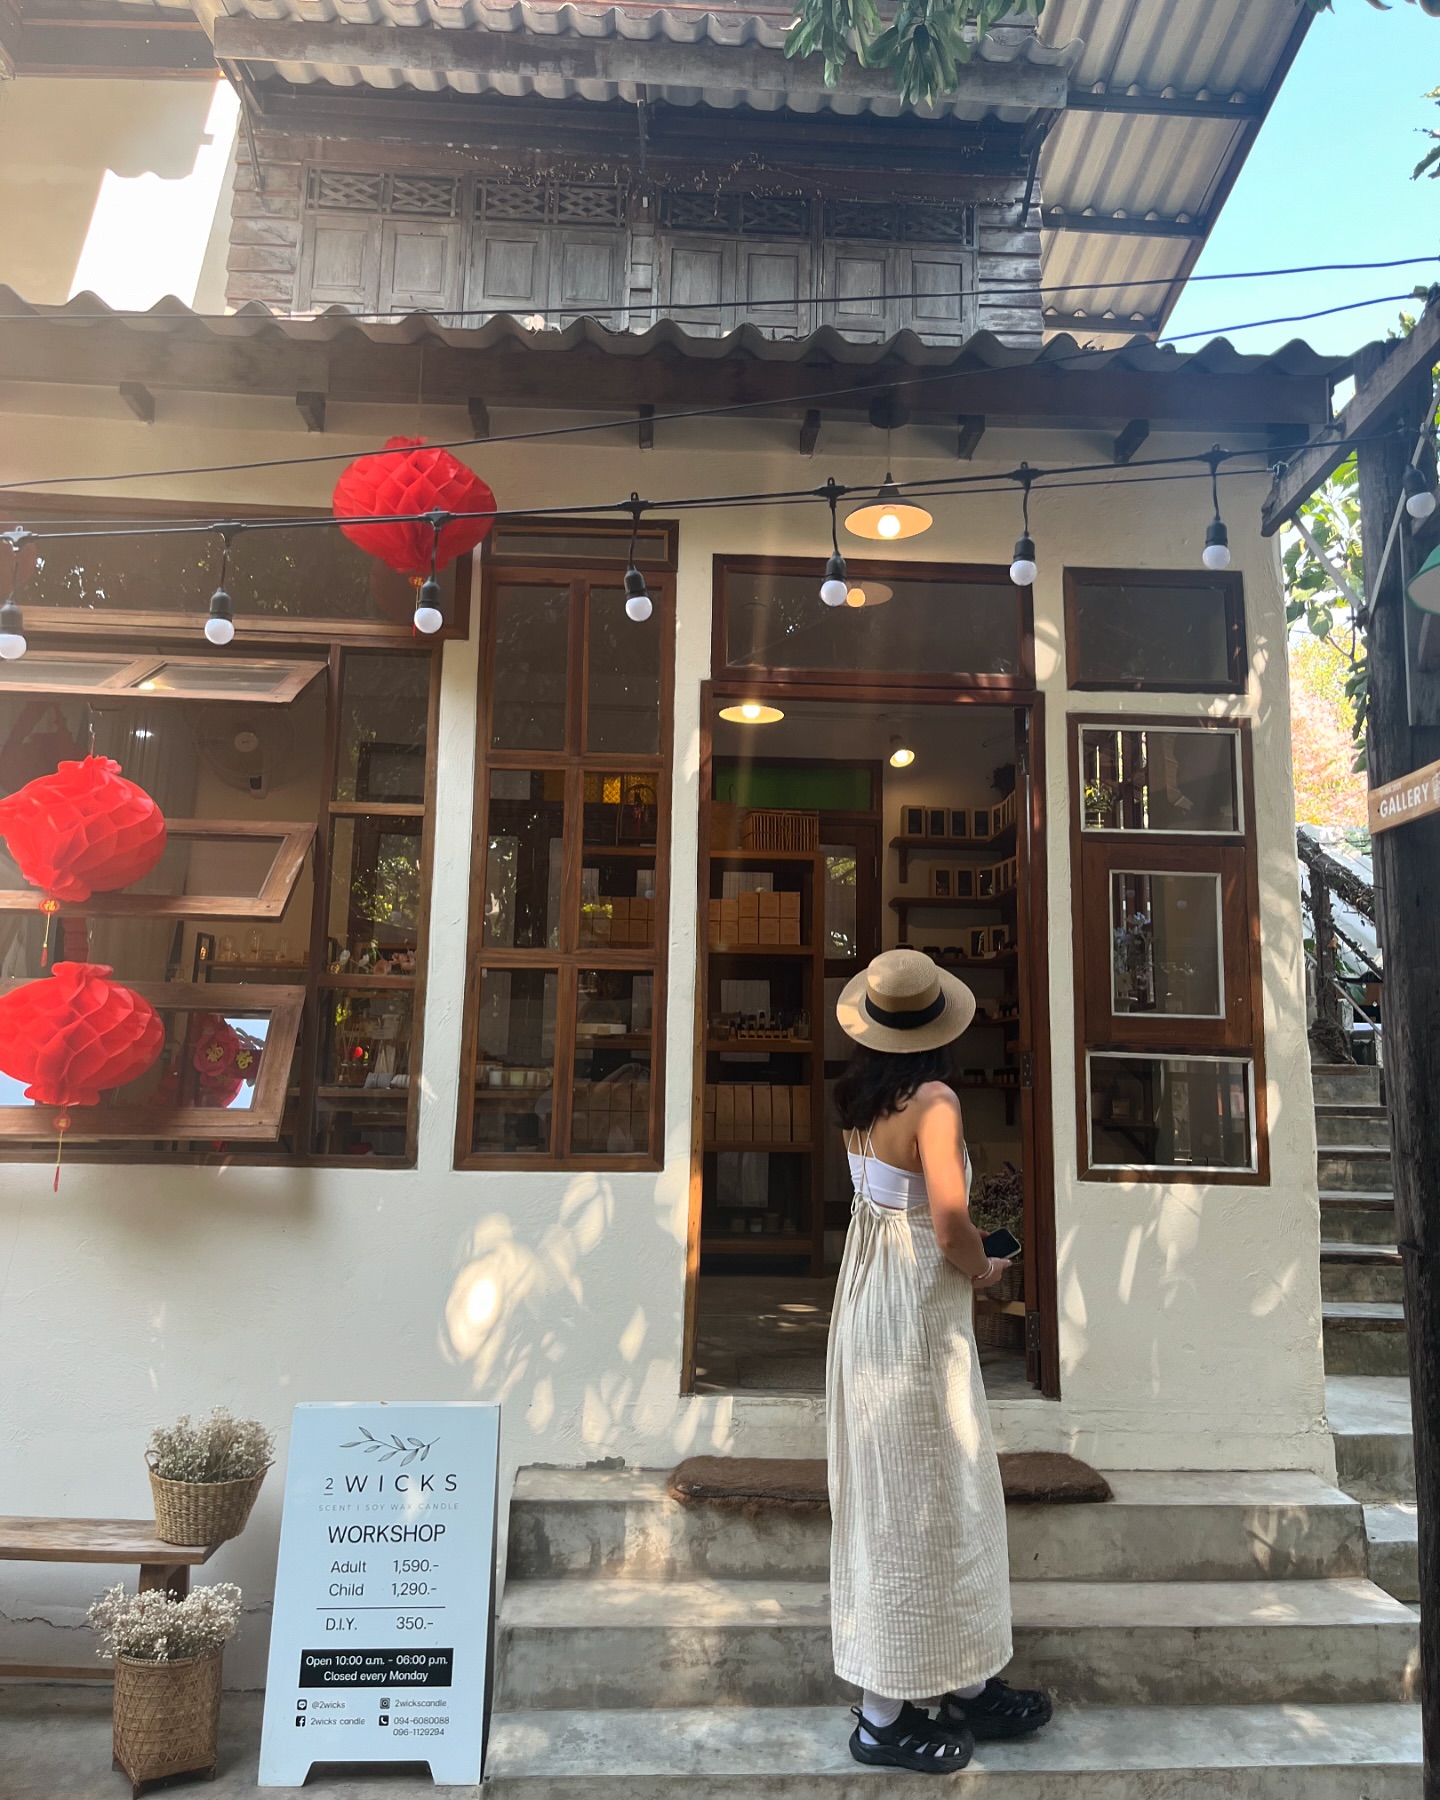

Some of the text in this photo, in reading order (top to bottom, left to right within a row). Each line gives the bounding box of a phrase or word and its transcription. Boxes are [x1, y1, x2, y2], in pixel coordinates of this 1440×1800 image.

[1380, 782, 1429, 818] GALLERY
[324, 1474, 457, 1493] 2 WICKS
[318, 1504, 352, 1512] SCENT
[365, 1503, 385, 1511] SOY
[391, 1503, 412, 1511] WAX
[418, 1502, 459, 1510] CANDLE
[328, 1524, 446, 1543] WORKSHOP
[330, 1559, 439, 1574] Adult 1,590.-
[329, 1582, 437, 1597] Child 1,290.-
[325, 1616, 434, 1631] D.I.Y. 350.-
[305, 1656, 332, 1667] Open
[335, 1655, 363, 1665] 10:00
[396, 1655, 426, 1665] 06:00
[324, 1671, 429, 1683] Closed every Monday
[311, 1700, 346, 1709] @2wicks
[394, 1699, 447, 1708] 2wickscandle
[310, 1717, 366, 1725] 2wicks candle
